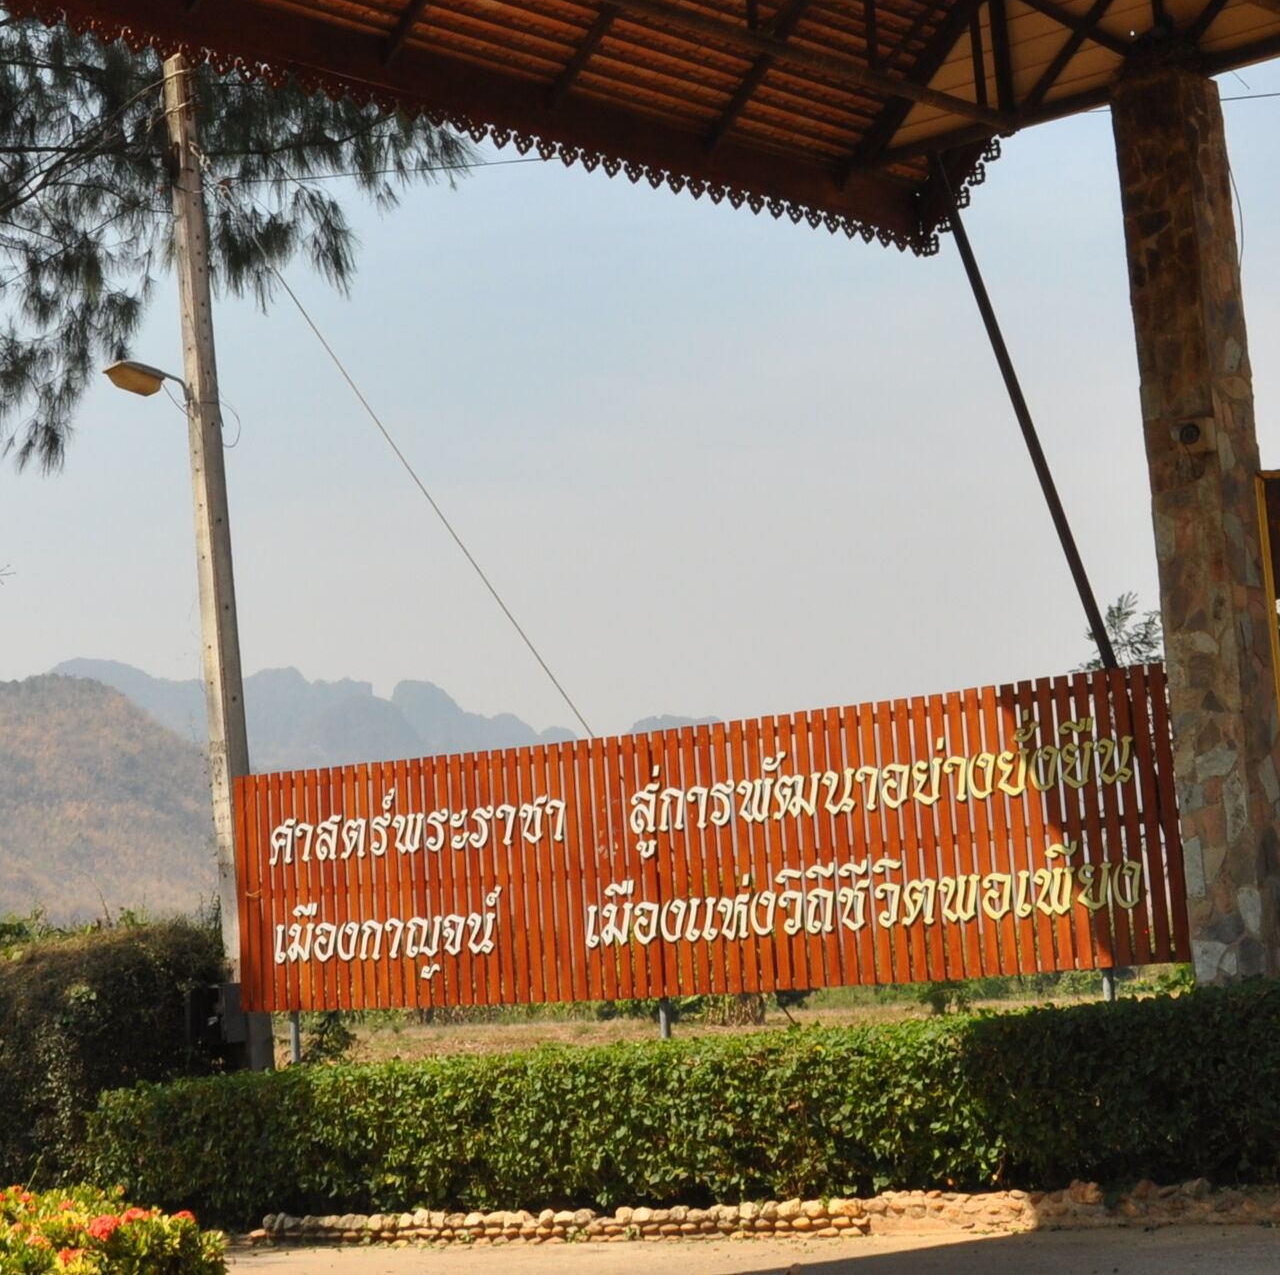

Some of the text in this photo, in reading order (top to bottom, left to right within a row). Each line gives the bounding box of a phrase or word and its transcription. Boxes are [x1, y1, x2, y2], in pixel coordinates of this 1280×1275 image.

[269, 709, 1133, 865] ศาสตร์พระราชา สู่การพัฒนาอย่างยั่งยืน
[273, 840, 1141, 979] เมืองกาญจน์ เมืองแห่งวิถีชีวิตพอเพียง
